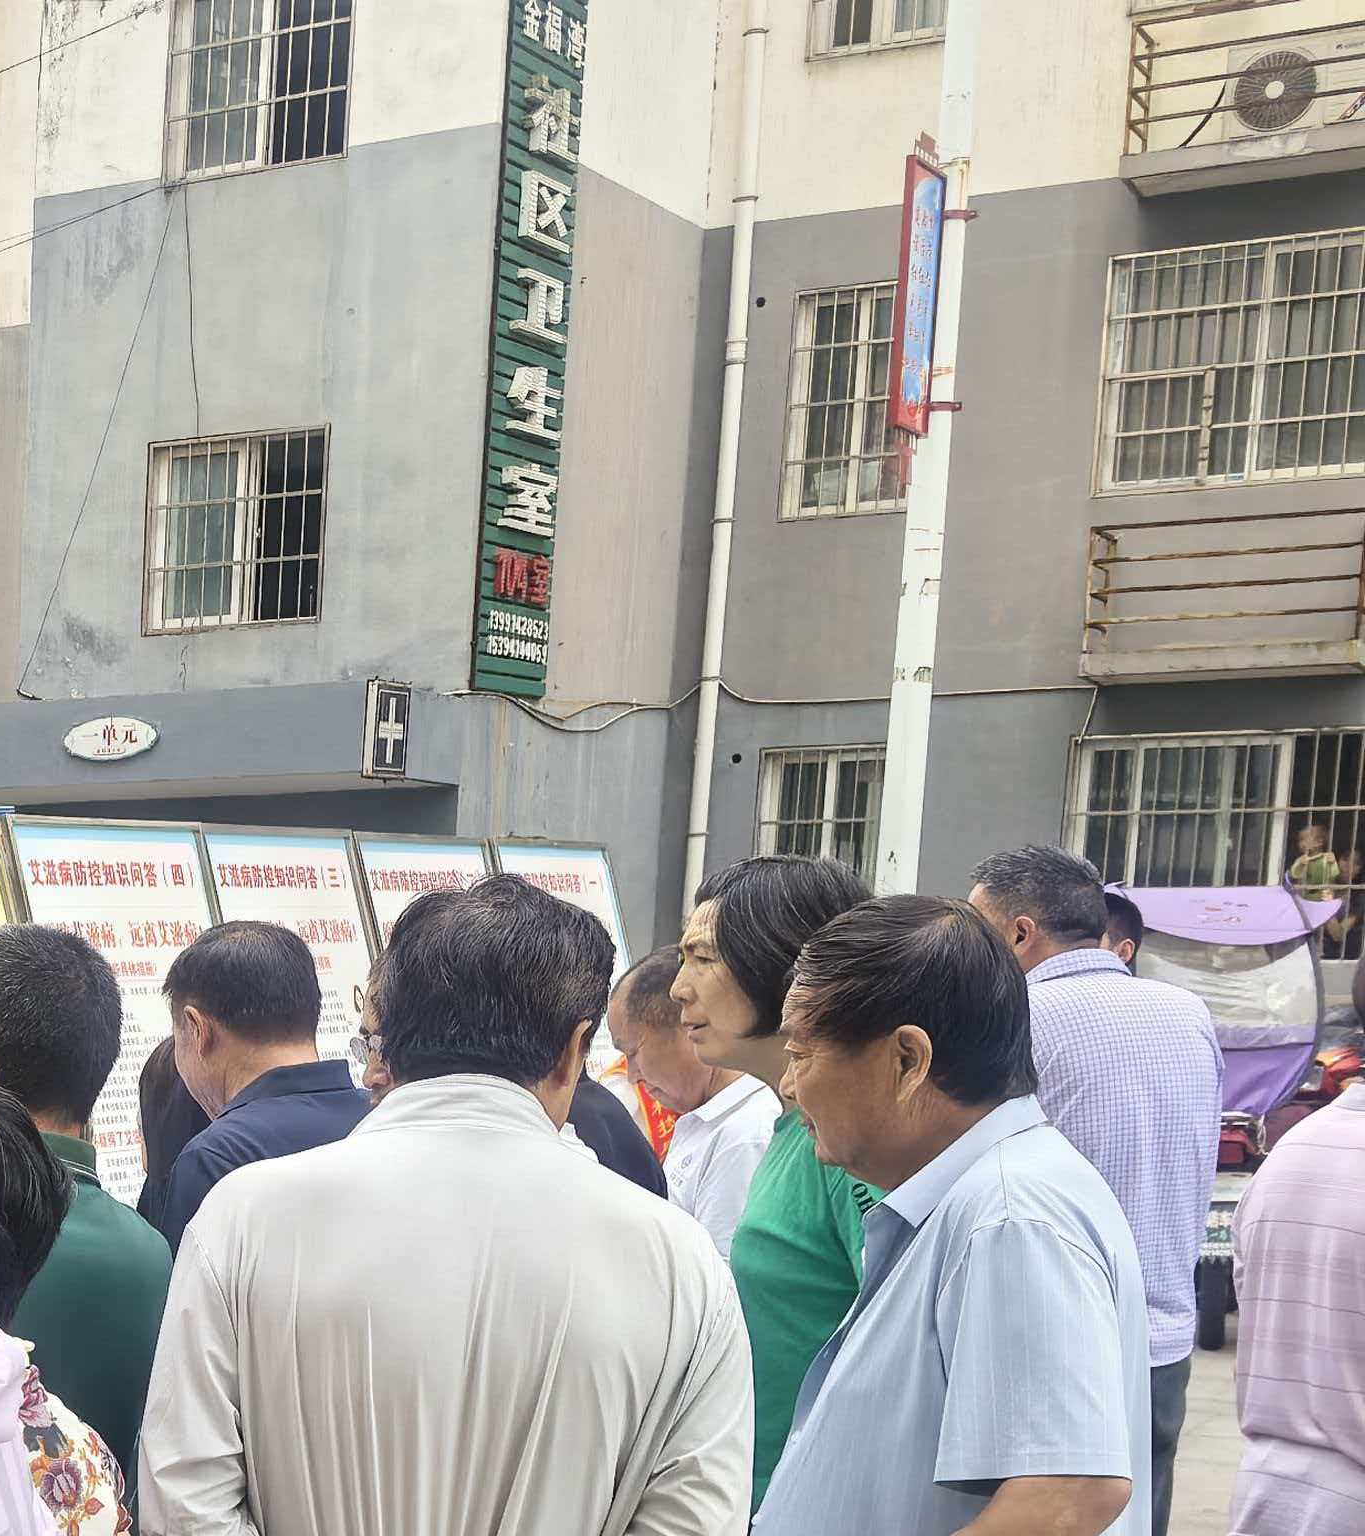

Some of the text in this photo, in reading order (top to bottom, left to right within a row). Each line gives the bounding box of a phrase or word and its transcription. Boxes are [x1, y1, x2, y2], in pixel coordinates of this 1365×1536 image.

[497, 73, 579, 538] 社区卫生室
[81, 724, 138, 746] 一单元
